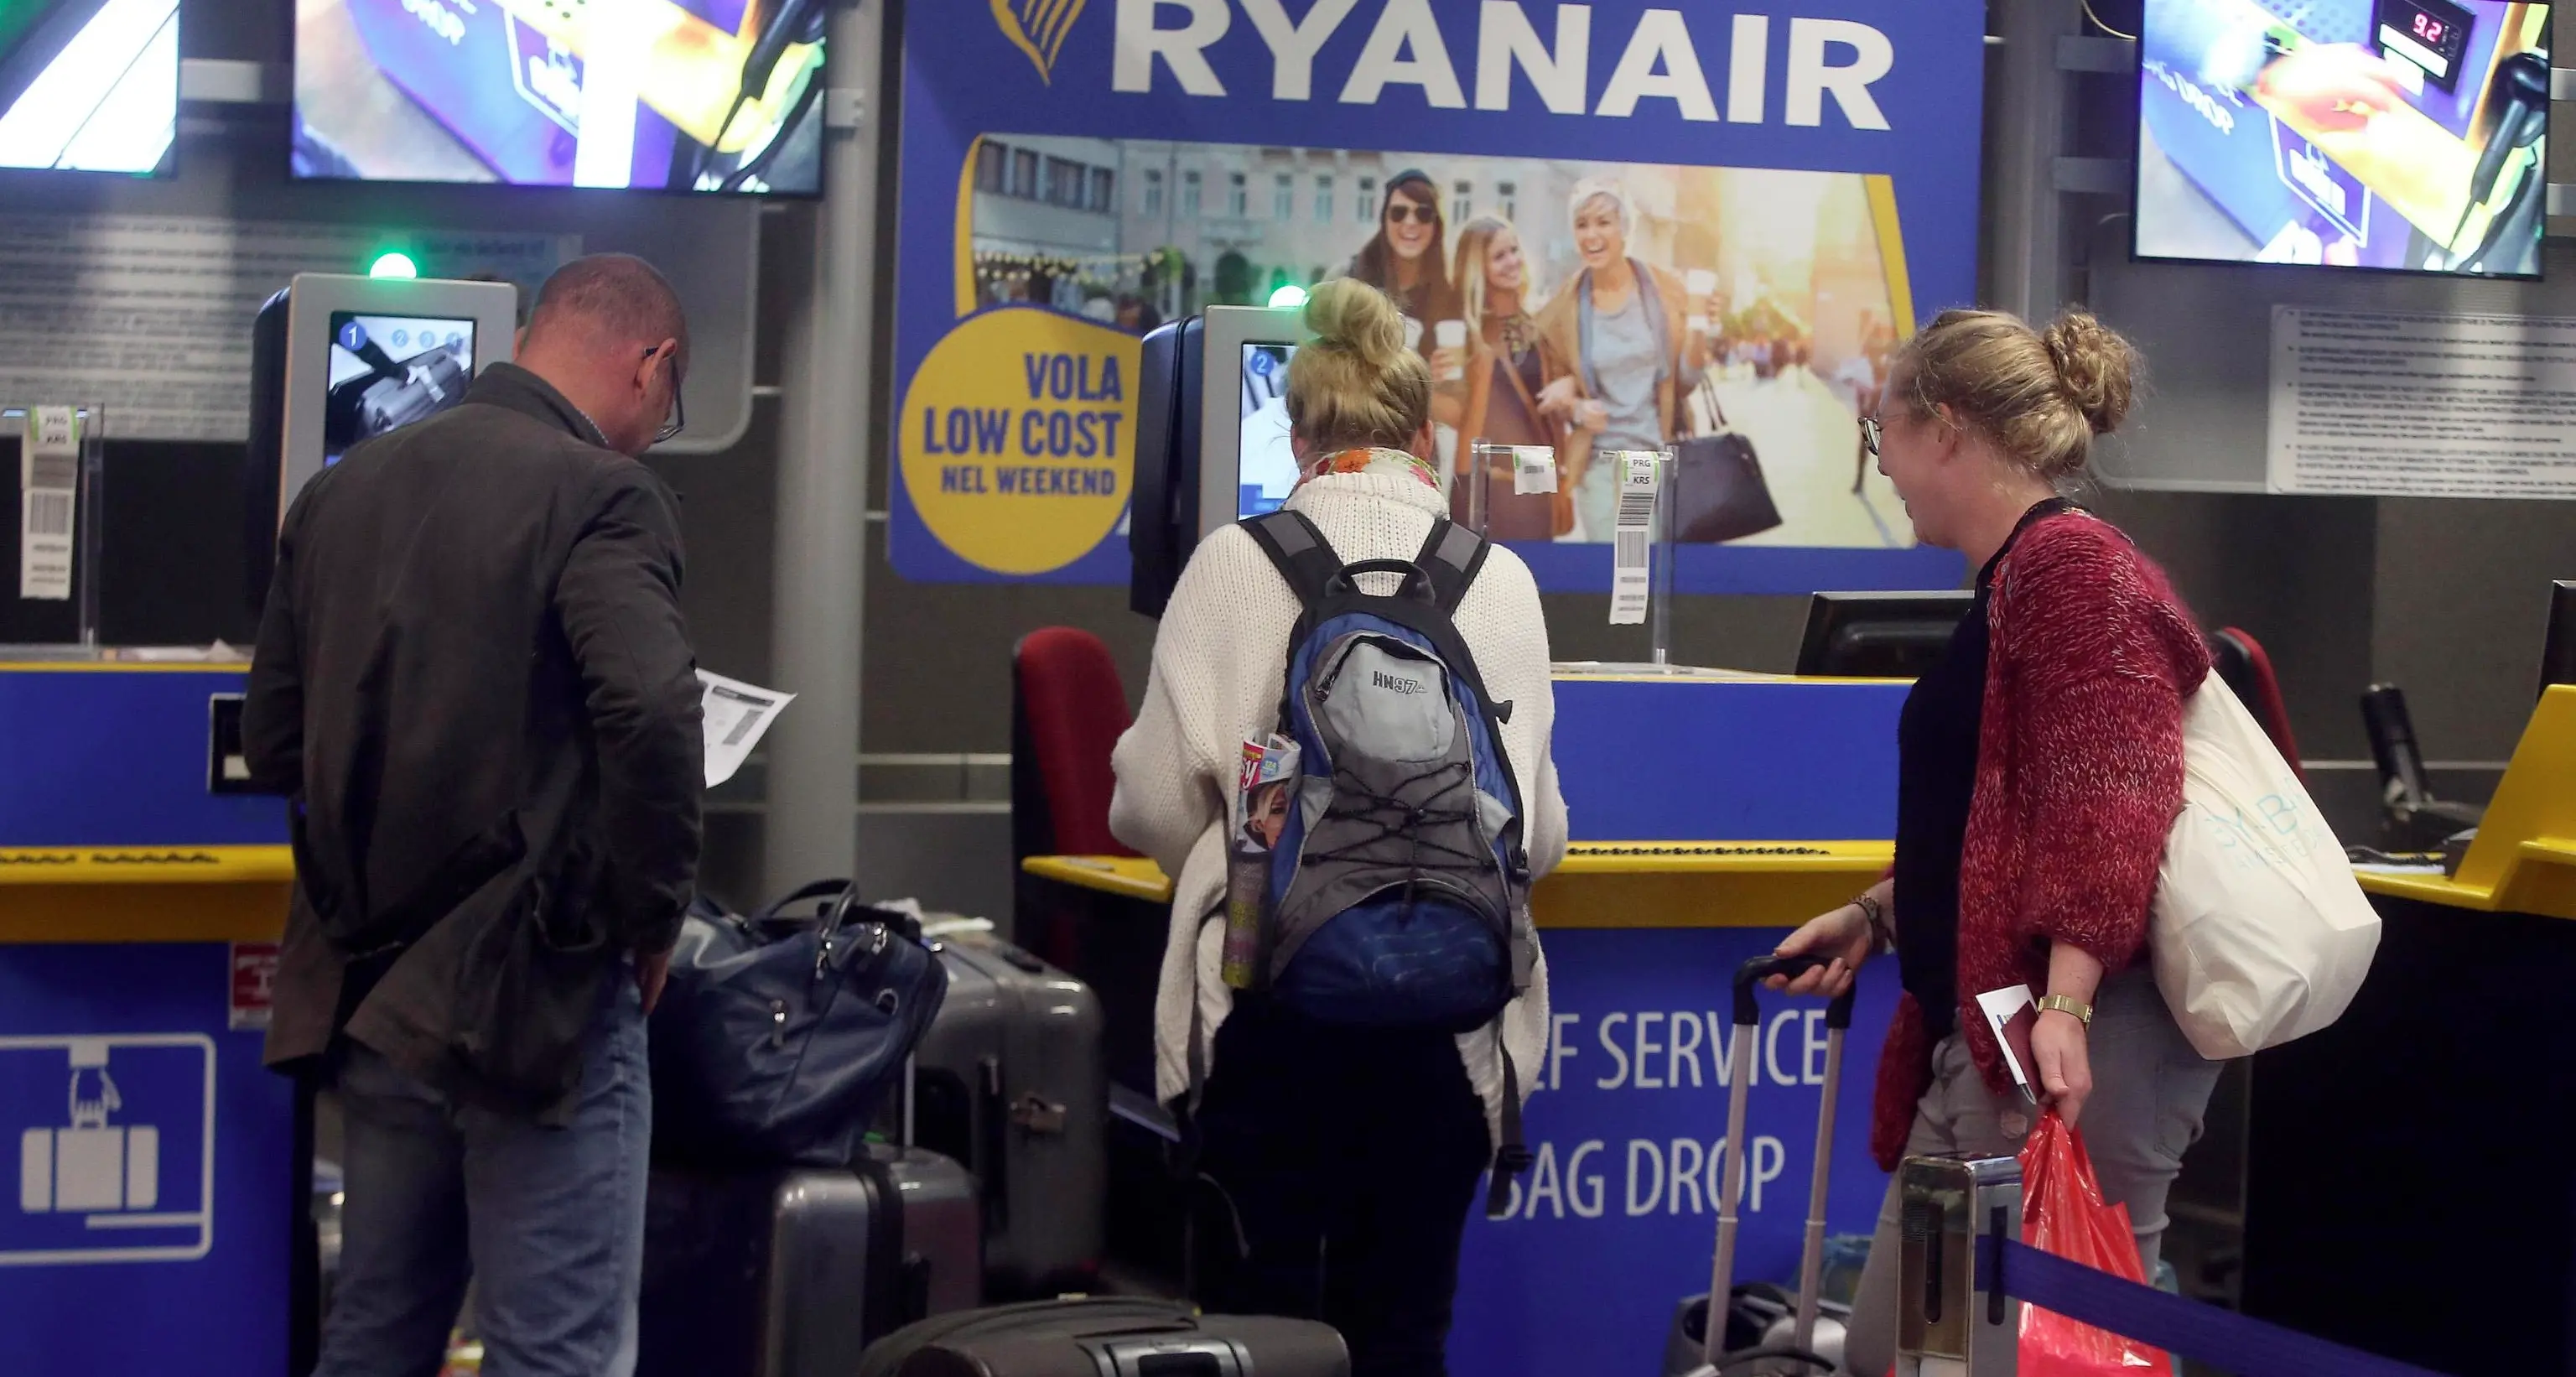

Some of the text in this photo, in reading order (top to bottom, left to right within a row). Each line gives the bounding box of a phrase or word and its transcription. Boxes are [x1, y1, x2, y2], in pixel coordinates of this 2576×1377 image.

[2412, 13, 2442, 42] 9.2
[1112, 0, 1894, 131] RYANAIR
[348, 325, 357, 347] 1
[1024, 352, 1123, 402] VOLA
[1256, 355, 1268, 374] 2
[923, 406, 1123, 457] LOW COST
[1633, 459, 1651, 467] PRG
[941, 465, 1116, 496] NEL WEEKEND
[1633, 476, 1650, 485] KRS
[1625, 1136, 1785, 1217] DROP
